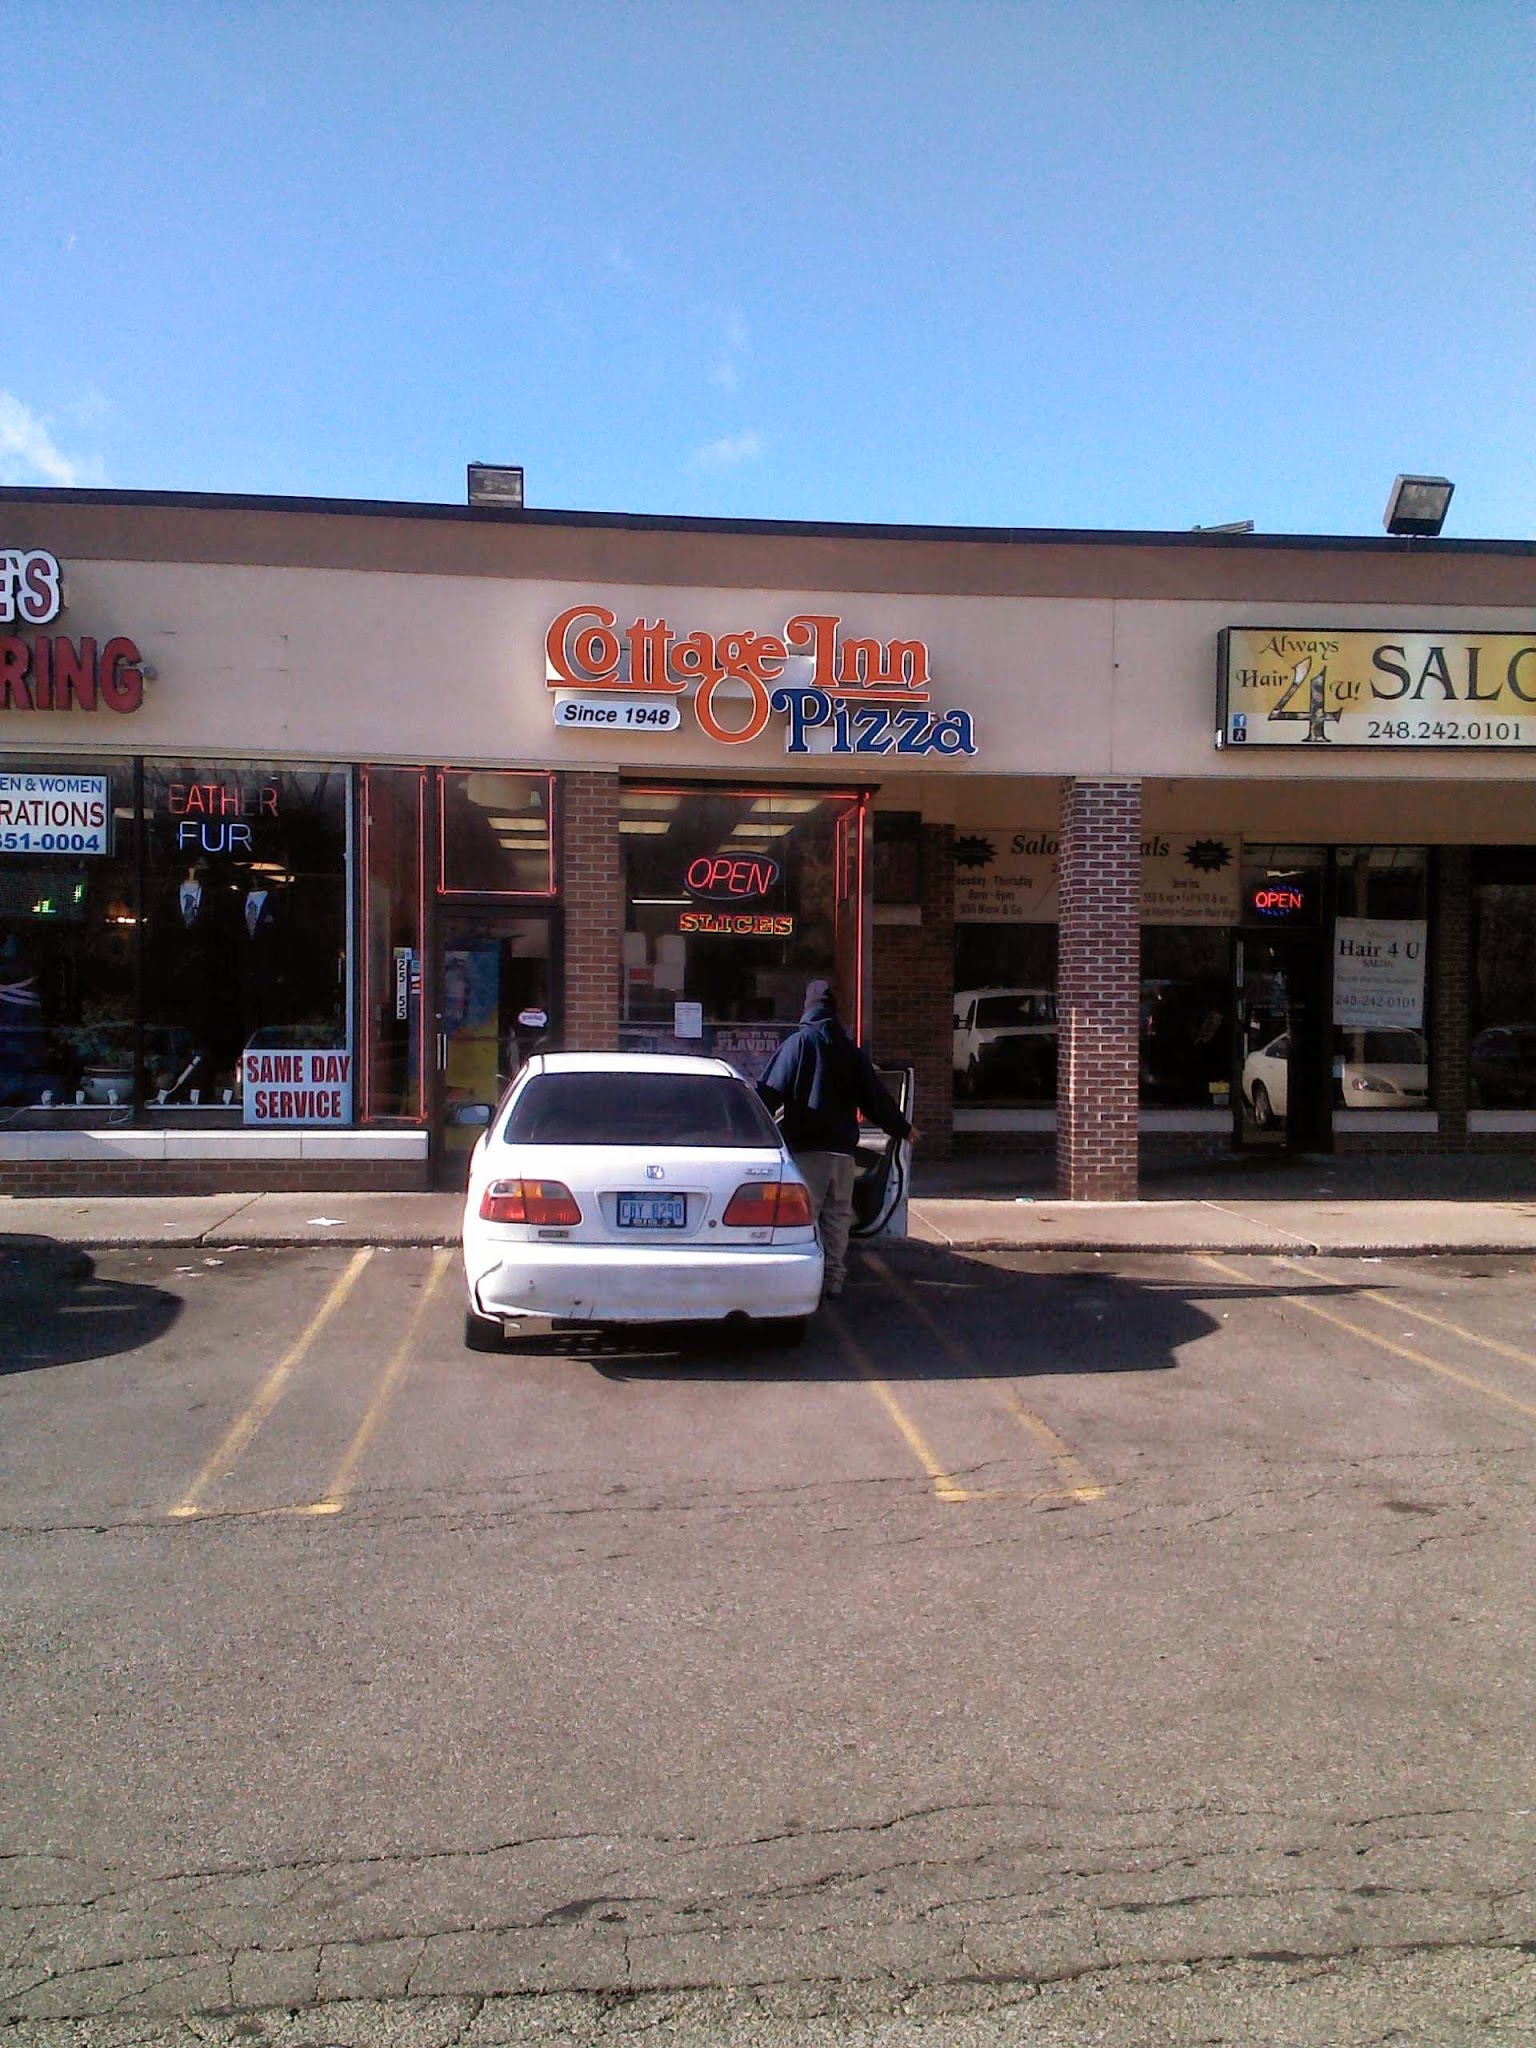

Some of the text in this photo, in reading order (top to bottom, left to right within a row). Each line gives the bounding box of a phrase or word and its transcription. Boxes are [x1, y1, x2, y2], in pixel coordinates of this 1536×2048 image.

[1259, 635, 1339, 660] Always
[545, 604, 931, 744] Cottage Inn
[1236, 669, 1288, 688] Hair
[1267, 656, 1344, 743] 4
[564, 705, 671, 726] Since 1948
[771, 687, 978, 756] Pizza
[1368, 721, 1521, 741] 248.242.0101
[26, 778, 36, 791] &
[40, 779, 102, 793] WOMEN
[0, 833, 99, 851] 51-0004
[179, 821, 252, 853] FUR
[688, 858, 773, 895] OPEN
[1255, 891, 1302, 908] OPEN
[680, 912, 793, 936] SLICES
[1340, 940, 1420, 959] Hair 4 U
[246, 1055, 351, 1083] SAME DAY
[255, 1090, 342, 1119] SERVICE
